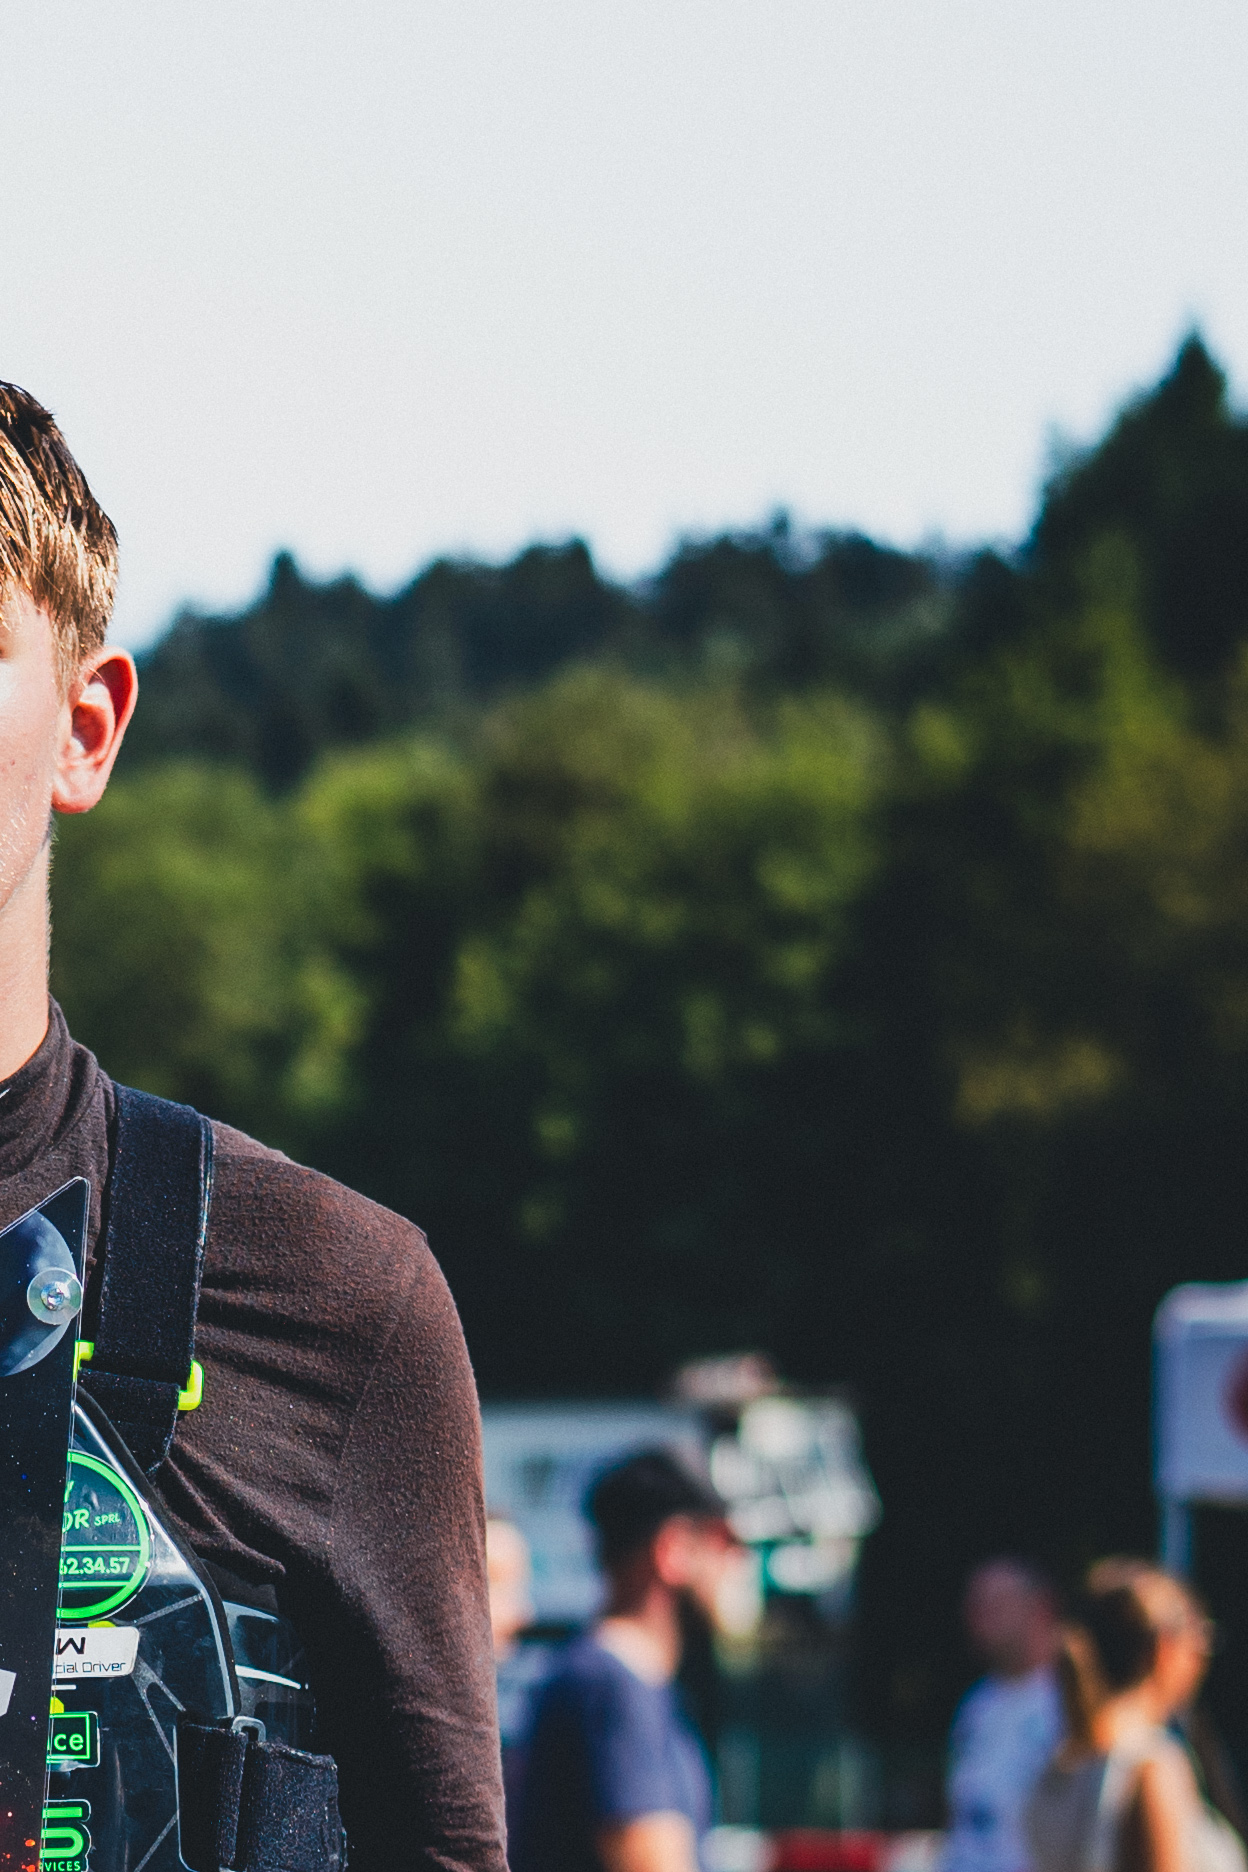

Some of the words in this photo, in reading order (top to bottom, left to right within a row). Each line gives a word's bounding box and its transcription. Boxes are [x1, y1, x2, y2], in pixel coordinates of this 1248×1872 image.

[94, 1512, 121, 1527] SPRL
[82, 1661, 127, 1673] Driver
[41, 1861, 82, 1872] VICES
